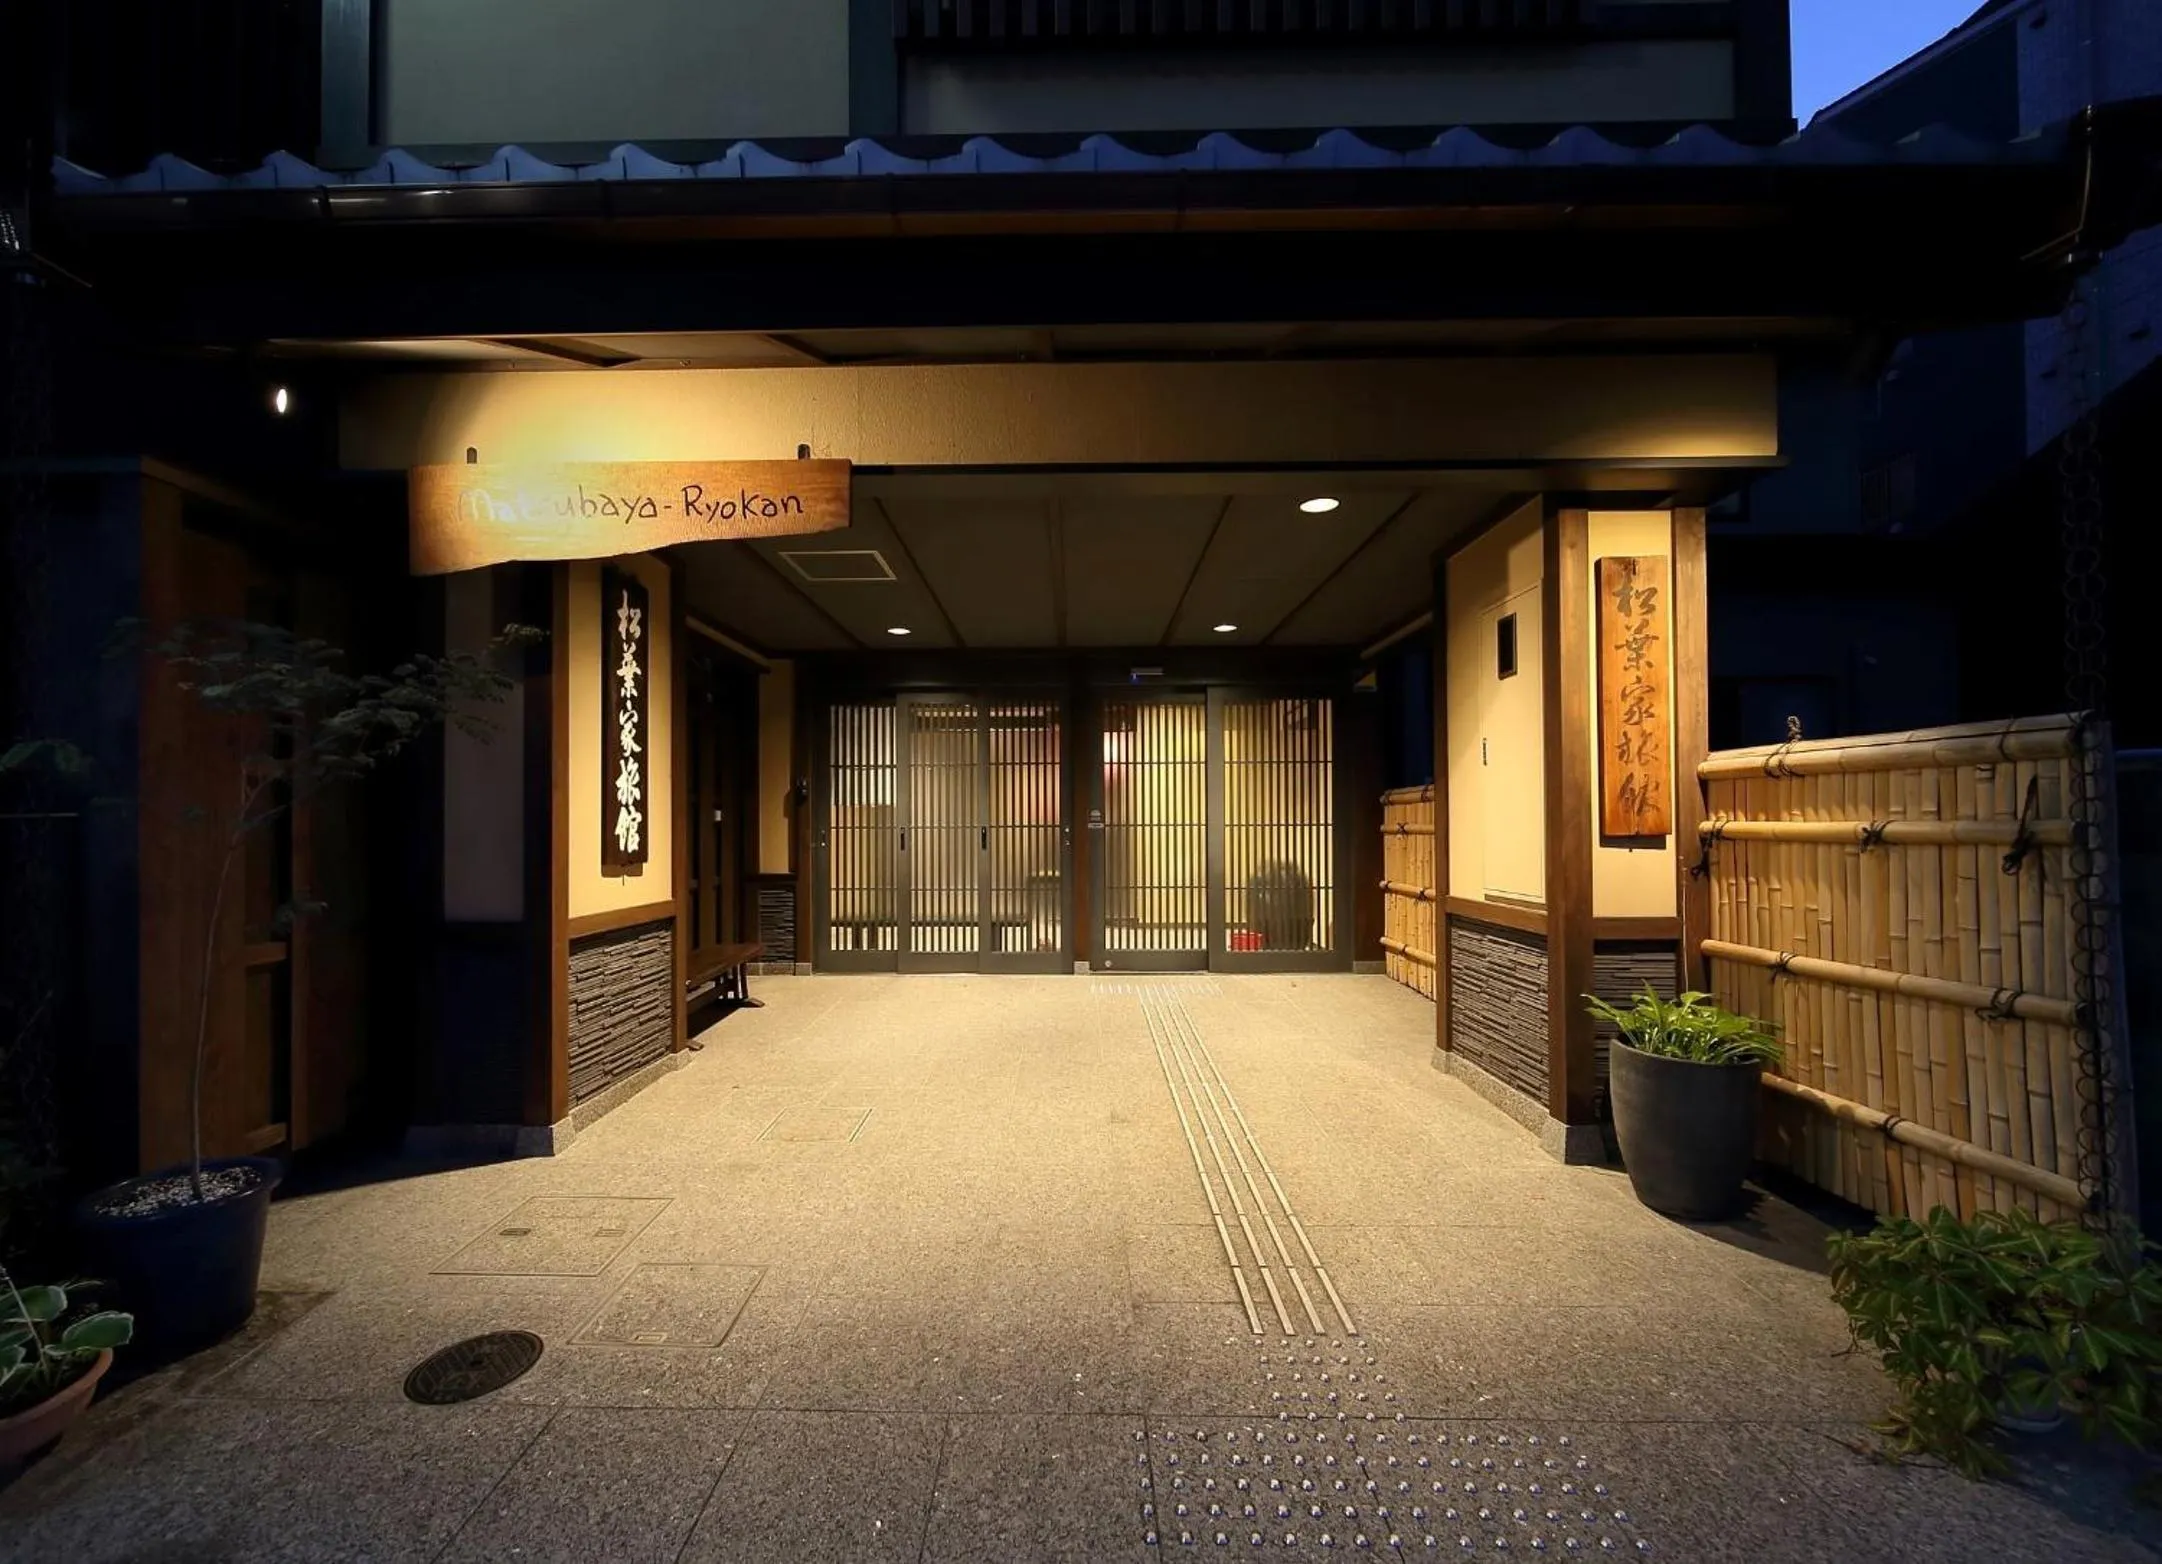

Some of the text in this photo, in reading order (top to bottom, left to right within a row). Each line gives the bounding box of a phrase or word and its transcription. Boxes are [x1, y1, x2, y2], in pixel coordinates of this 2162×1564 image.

[457, 484, 804, 524] Matubaya-Ryokan
[614, 588, 642, 854] 松葉家旅館
[1611, 572, 1660, 818] 松葉家旅館
